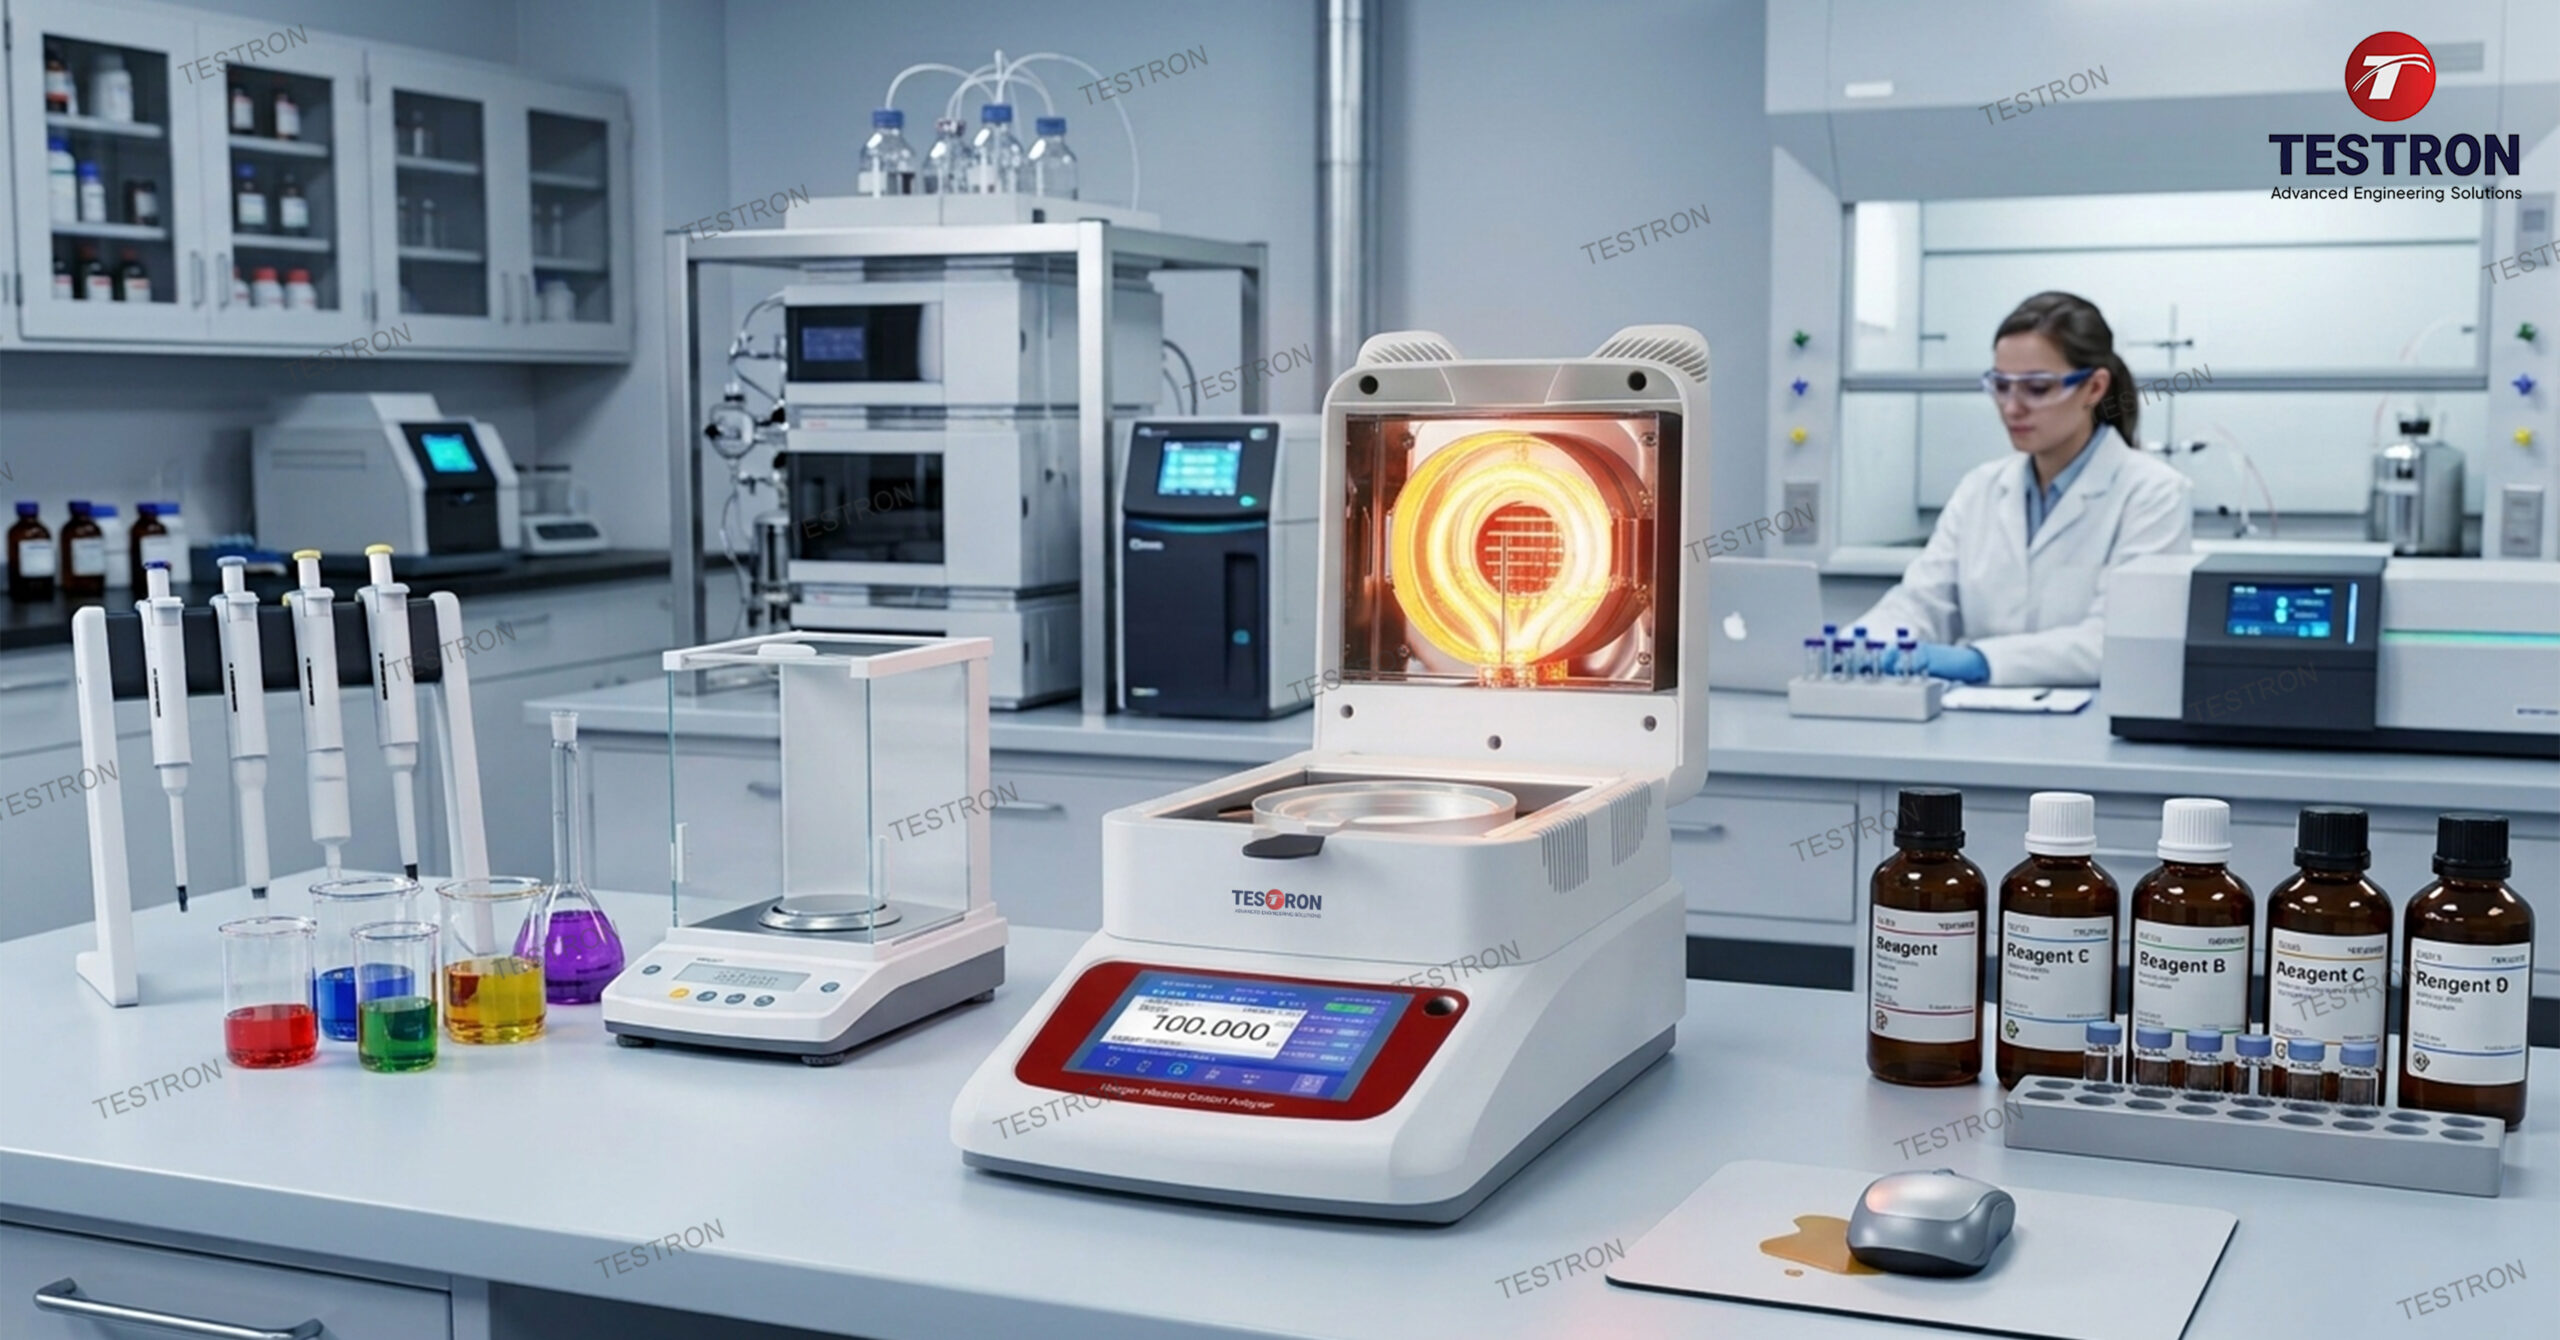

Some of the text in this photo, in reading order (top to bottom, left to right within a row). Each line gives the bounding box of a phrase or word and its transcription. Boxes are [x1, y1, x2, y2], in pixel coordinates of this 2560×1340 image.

[1232, 889, 1322, 911] TESTRON
[2007, 942, 2090, 965] Reagent C
[2140, 951, 2226, 975] Reagent B
[2352, 967, 2365, 982] C
